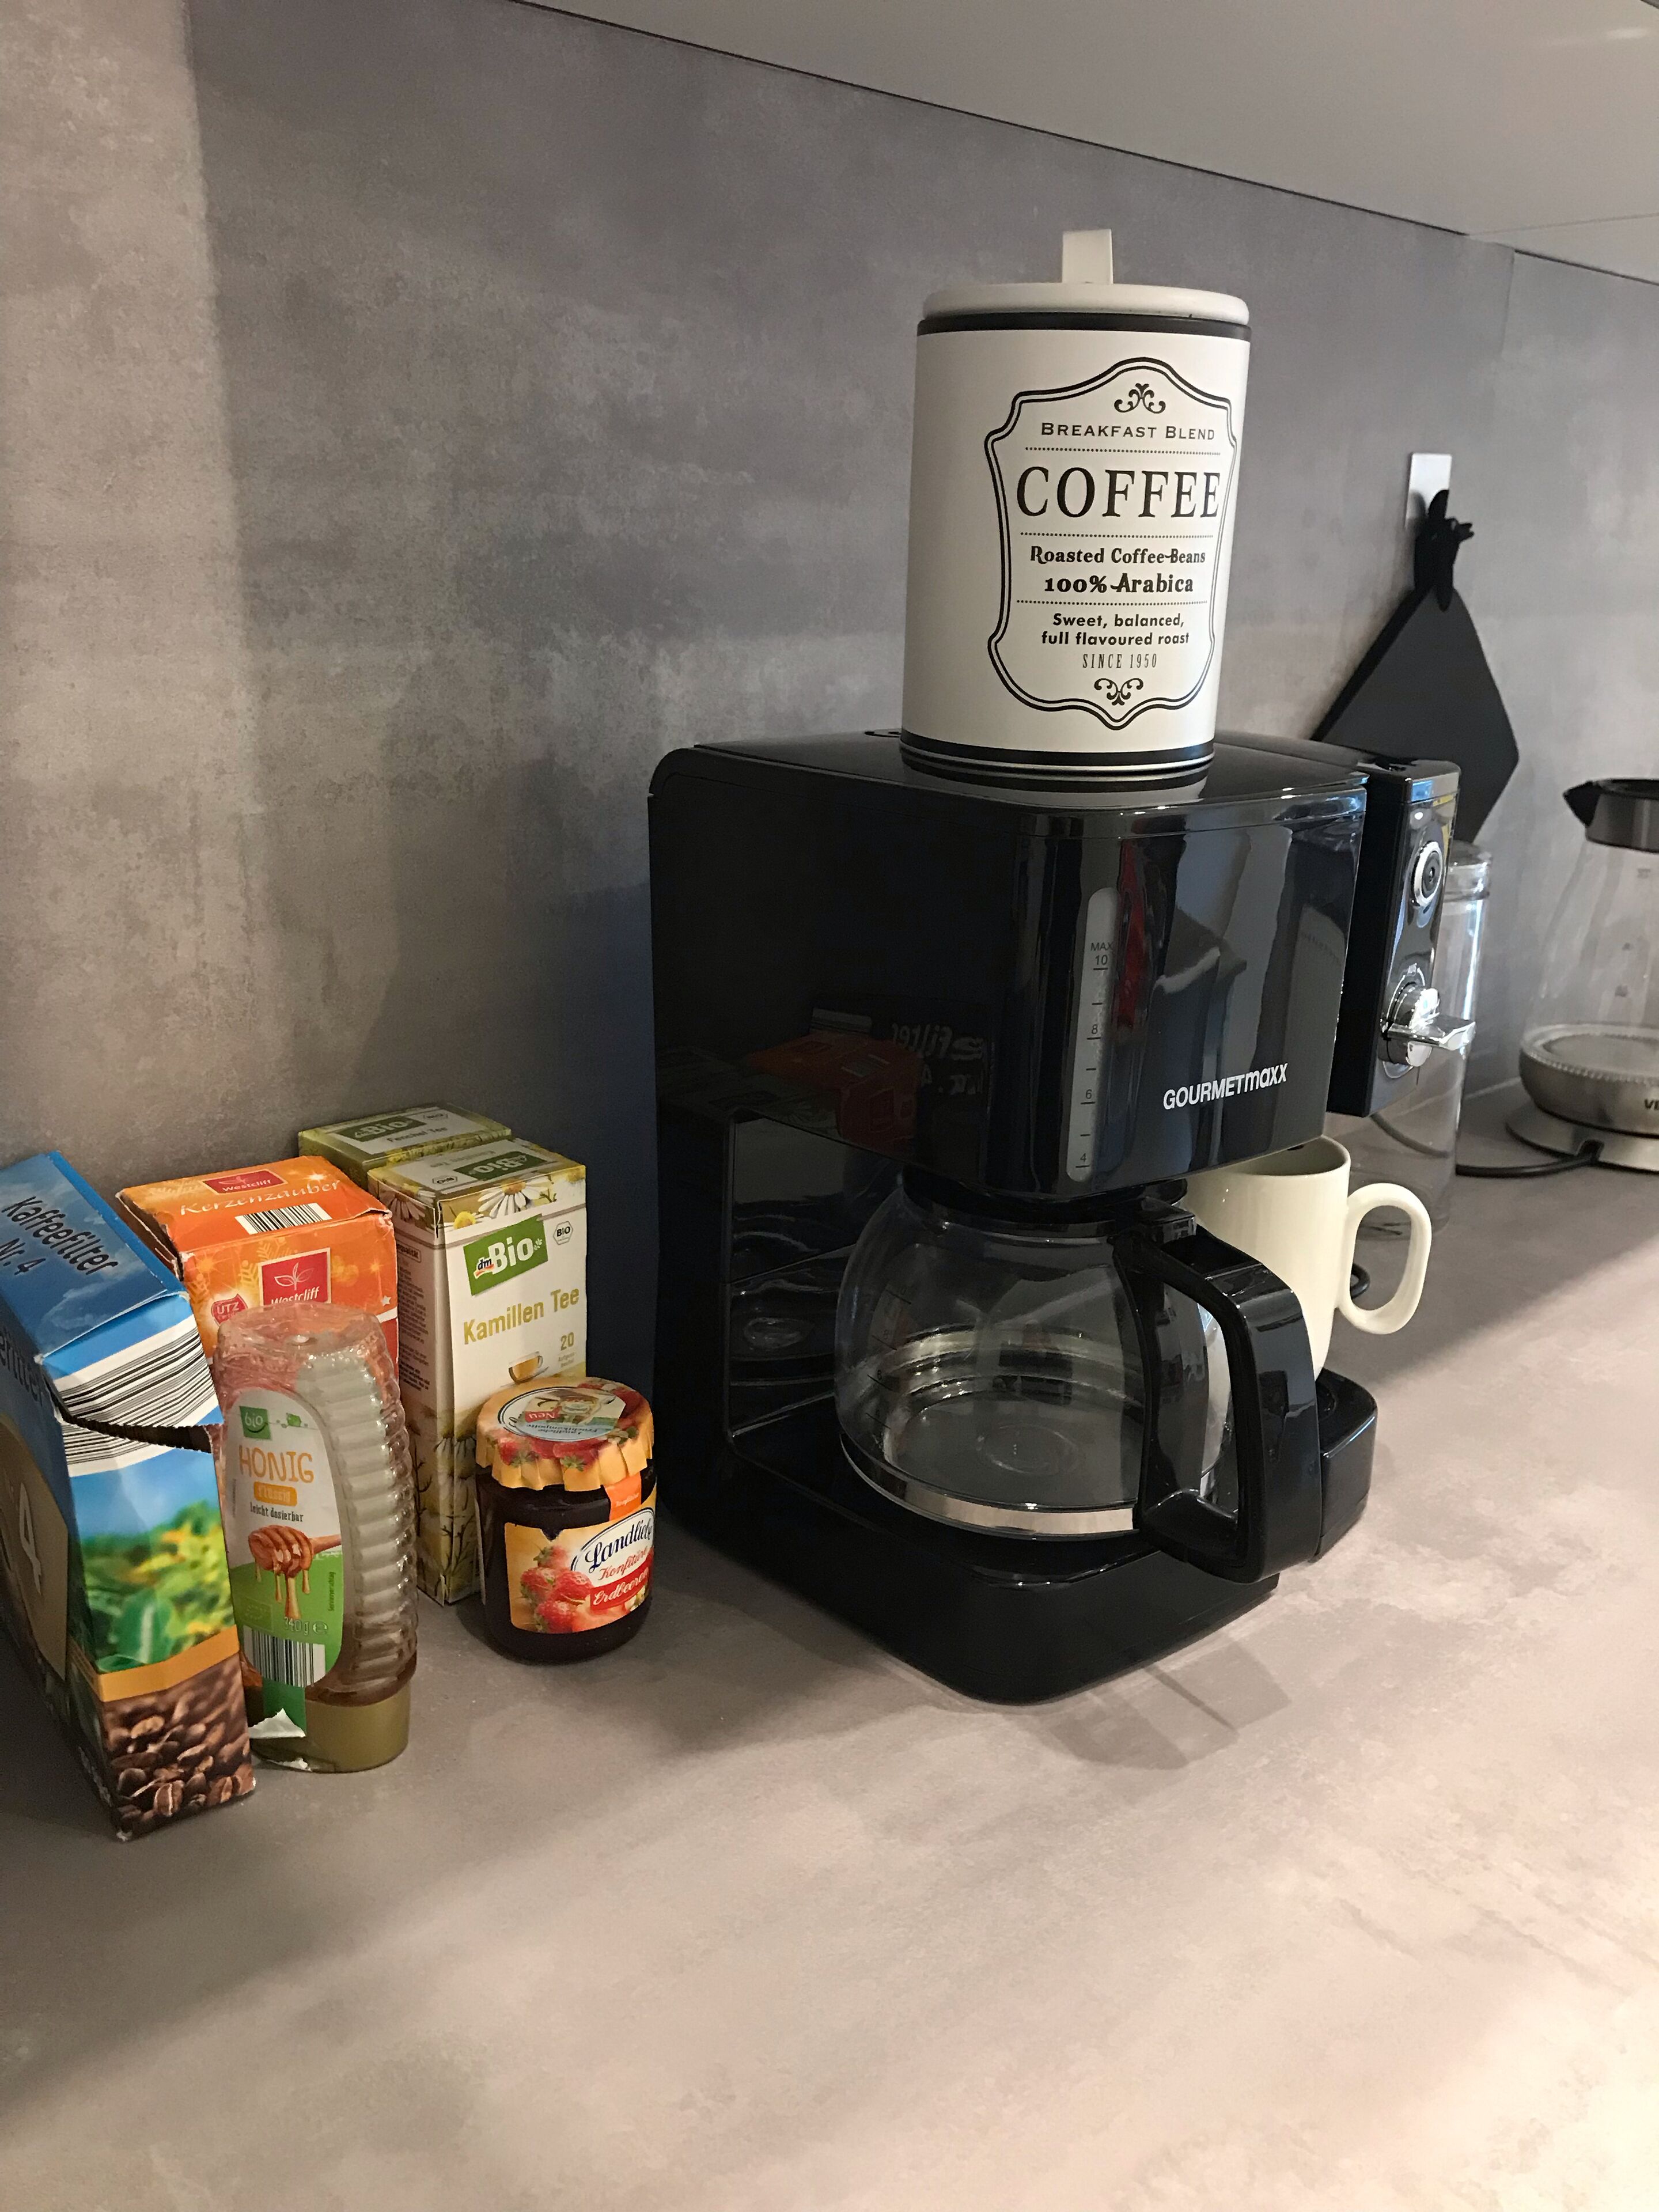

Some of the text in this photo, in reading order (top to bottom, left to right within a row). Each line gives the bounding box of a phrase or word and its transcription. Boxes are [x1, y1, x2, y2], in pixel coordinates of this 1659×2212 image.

[1041, 422, 1215, 441] BREAKFAST BLEND
[1016, 465, 1221, 518] COFFEE
[1030, 546, 1105, 565] Roasted
[1044, 577, 1107, 594] 100%
[1052, 613, 1185, 629] Sweet, balanced,
[1041, 631, 1190, 646] full flavoured roast
[1082, 653, 1158, 669] SINCE 1950
[1090, 942, 1113, 952] MAX
[1094, 955, 1108, 965] 10
[1092, 1024, 1098, 1035] 8
[1085, 1089, 1092, 1099] 6
[1080, 1153, 1086, 1162] 4
[222, 1179, 272, 1192] Westcliff
[180, 1179, 341, 1216] Kerzenzauber
[2, 1196, 119, 1275] Kaffeefilter
[0, 1237, 47, 1275] Nr. 4
[217, 1301, 240, 1315] UTZ
[463, 1300, 544, 1344] Kamillen
[550, 1287, 580, 1313] Tee
[560, 1331, 575, 1351] 20
[243, 1412, 264, 1428] bio
[238, 1445, 315, 1484] HONIG
[250, 1501, 304, 1523] leicht dosierbar
[283, 1616, 302, 1633] 340
[303, 1620, 310, 1636] g
